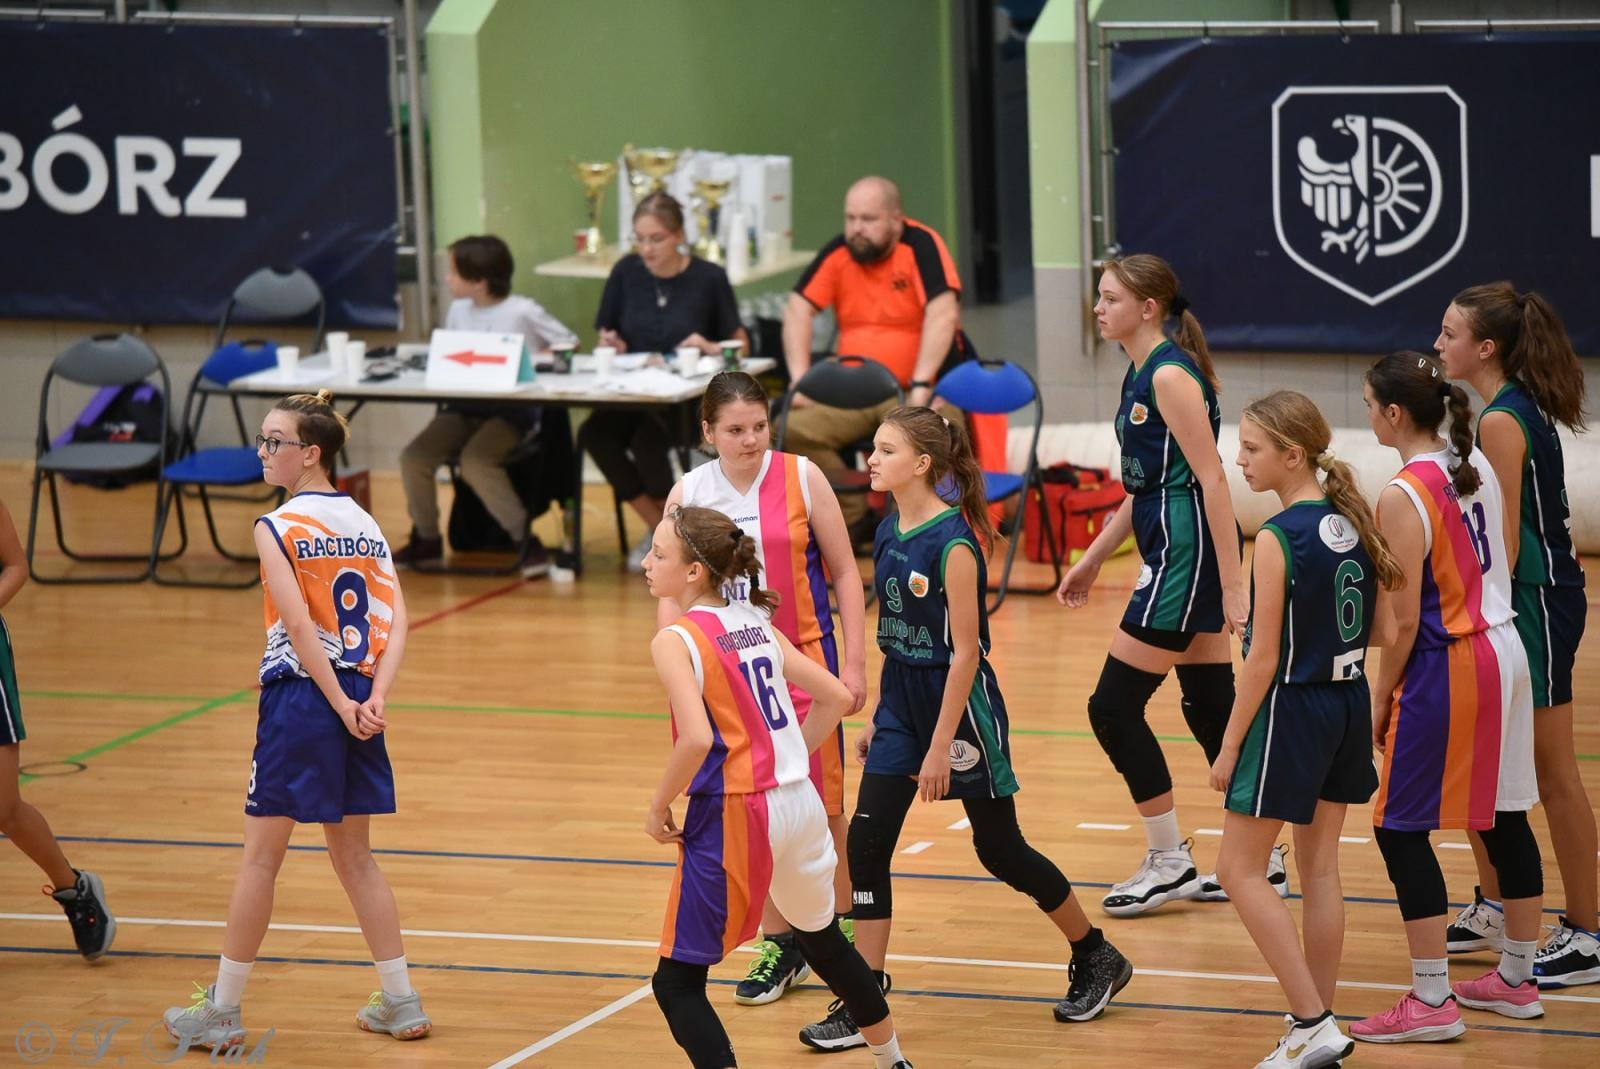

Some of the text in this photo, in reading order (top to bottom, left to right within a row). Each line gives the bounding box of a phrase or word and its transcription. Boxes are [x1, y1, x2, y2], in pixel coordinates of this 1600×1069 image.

[295, 532, 387, 559] RACIBÓRZ
[1461, 501, 1492, 575] 13
[885, 577, 903, 613] 9
[1334, 559, 1364, 642] 6
[331, 570, 370, 663] 8
[716, 624, 771, 654] RACIBÓRZ
[737, 656, 789, 731] 16
[248, 760, 257, 794] 8
[858, 891, 874, 904] NBA
